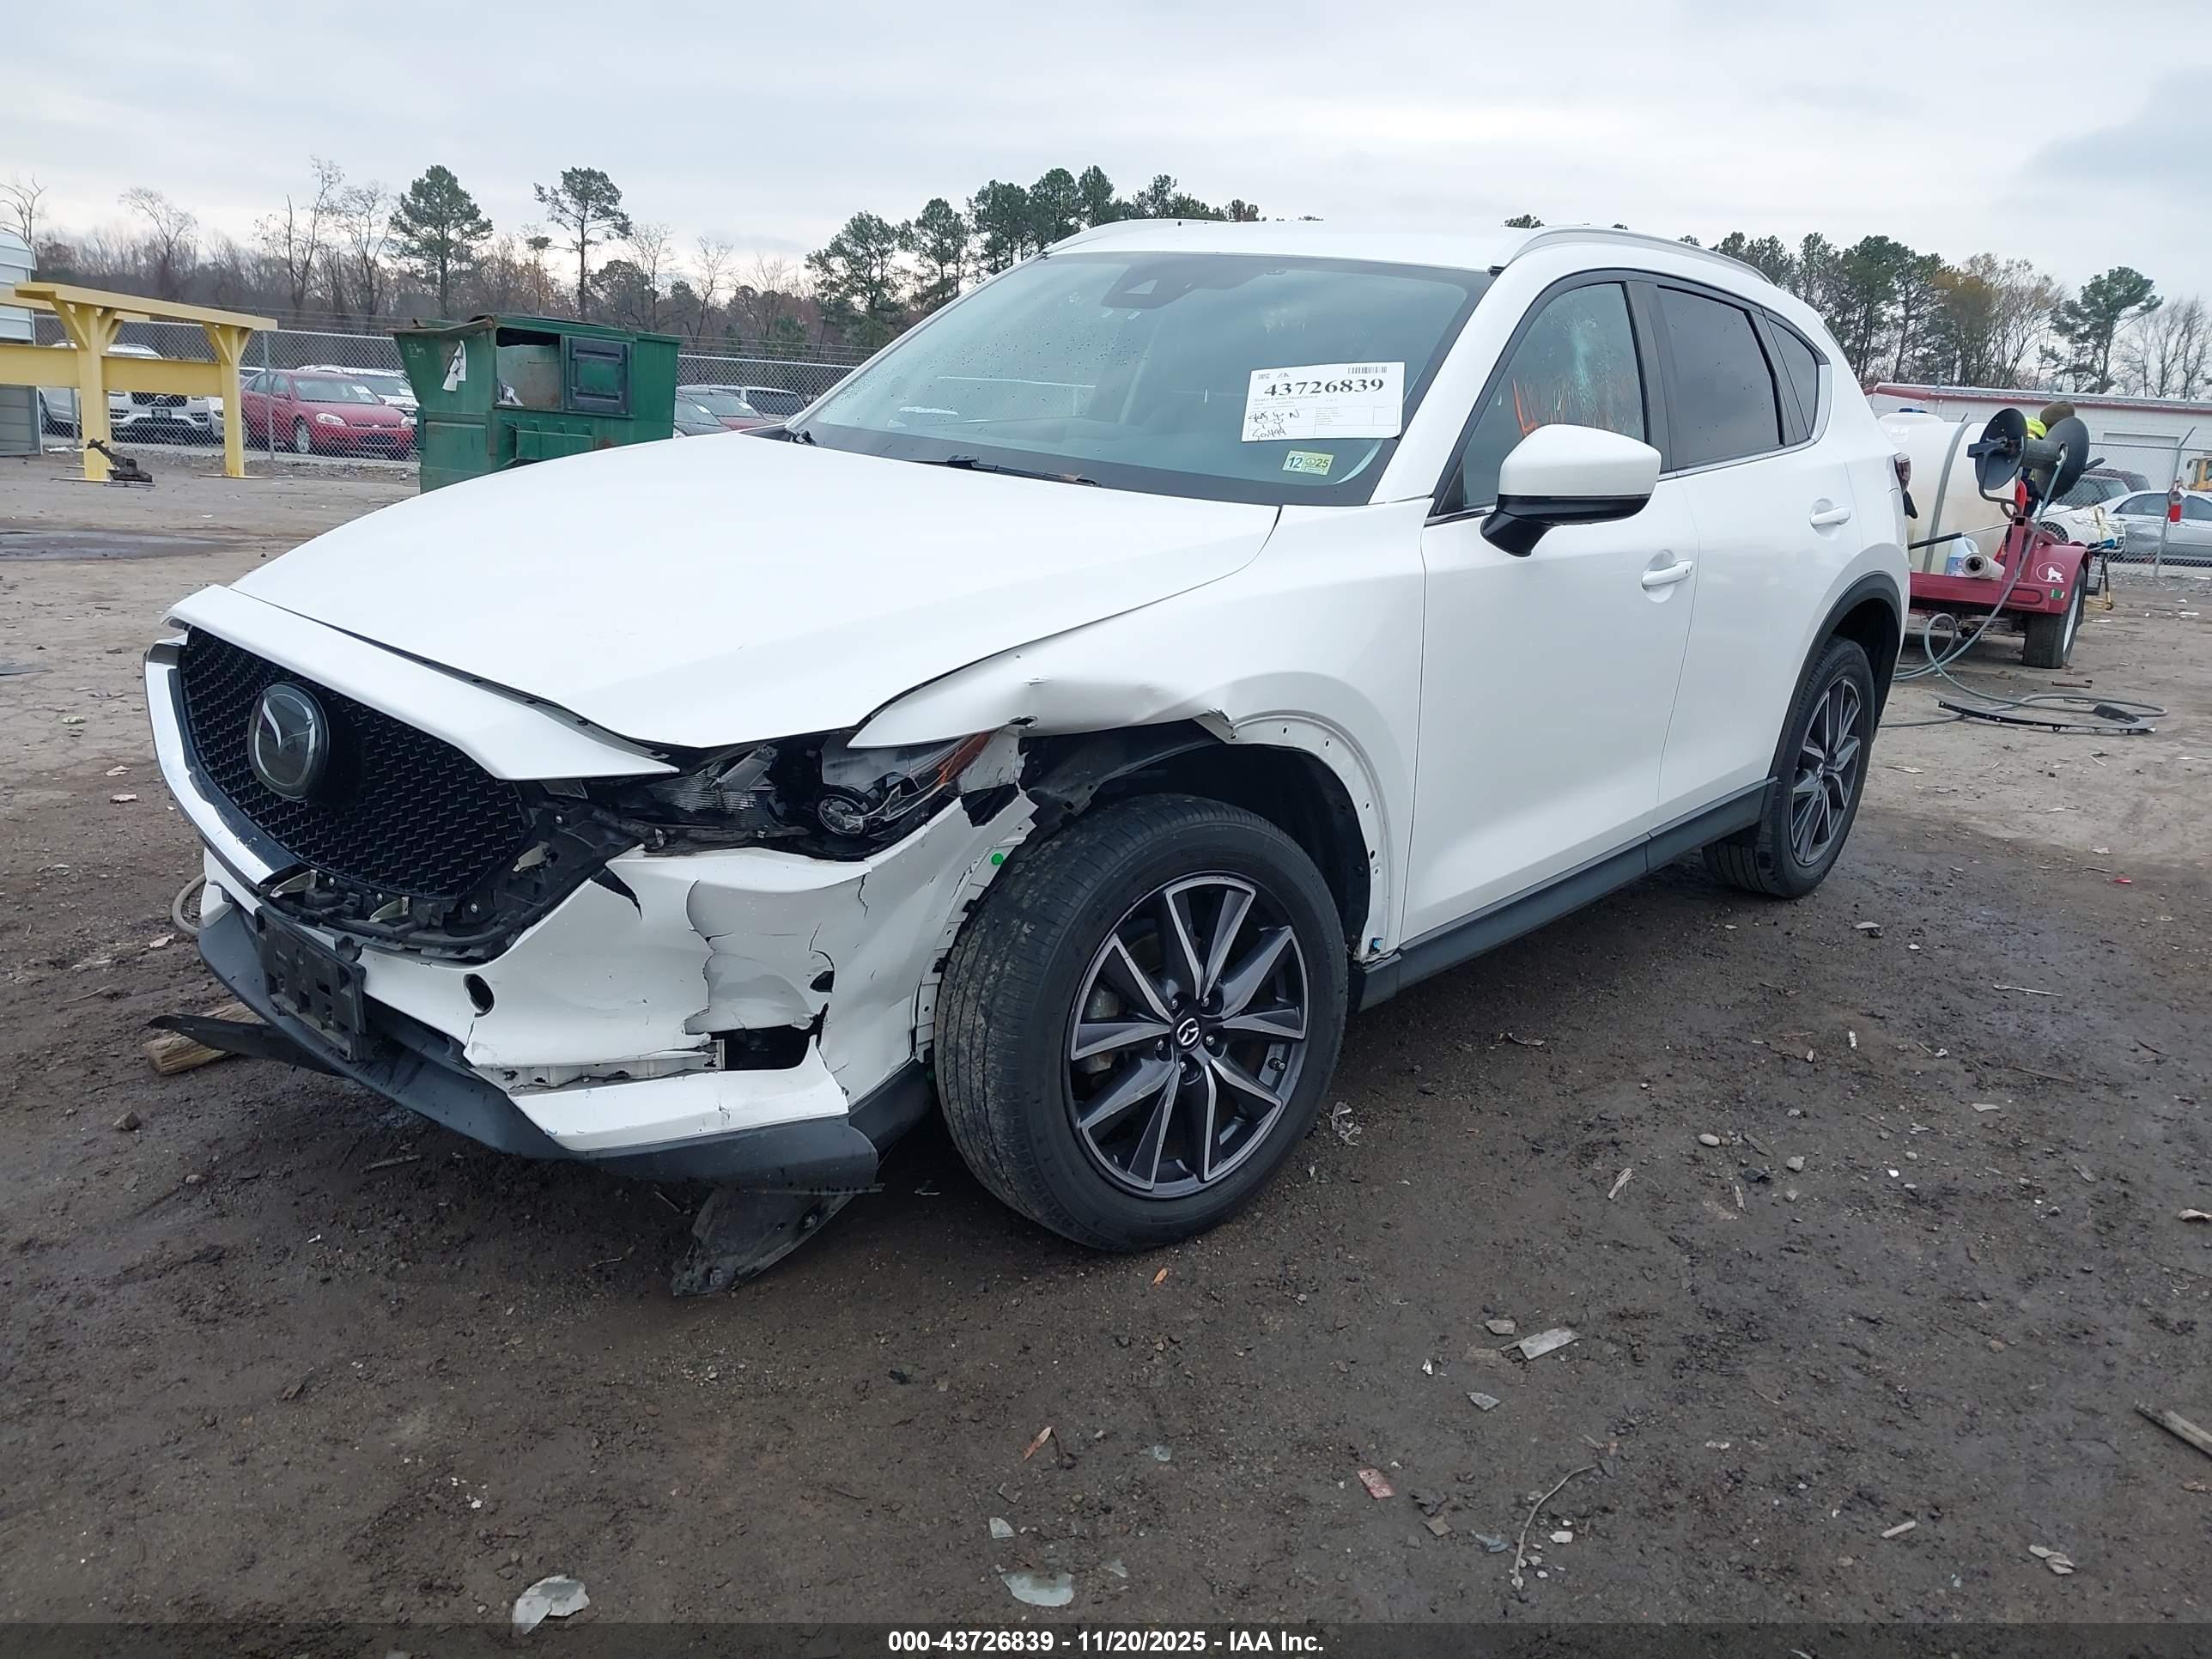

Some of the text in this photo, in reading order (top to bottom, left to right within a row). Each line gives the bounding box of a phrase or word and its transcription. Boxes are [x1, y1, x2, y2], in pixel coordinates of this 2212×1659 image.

[1263, 378, 1384, 397] 43726839
[1289, 456, 1330, 469] 12 25
